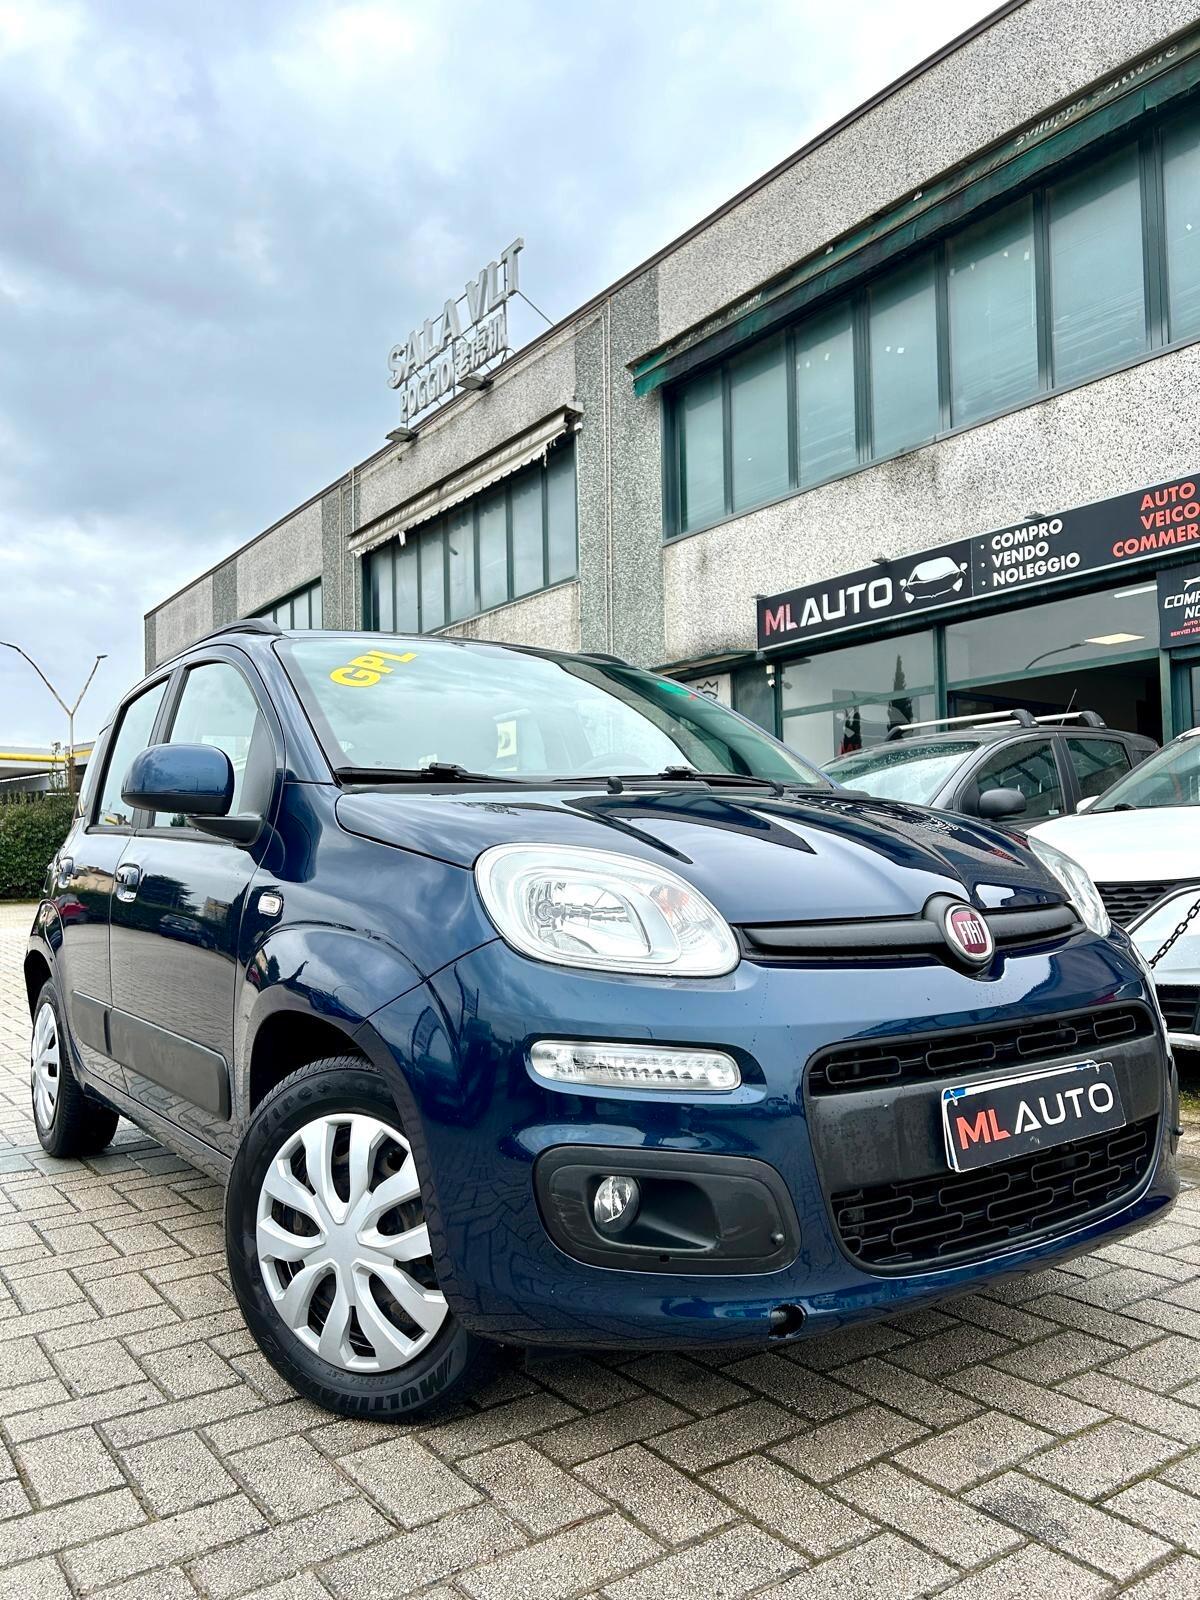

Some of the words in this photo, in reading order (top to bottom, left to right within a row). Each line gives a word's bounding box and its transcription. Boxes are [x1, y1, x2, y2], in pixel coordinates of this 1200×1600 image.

[387, 298, 461, 390] SALA
[465, 237, 524, 326] VLT
[1140, 482, 1196, 512] AUTO
[991, 518, 1063, 550] COMPRO
[1112, 523, 1200, 558] COMMER
[991, 541, 1049, 568] VENDO
[993, 552, 1081, 587] NOLEGGIO
[329, 650, 419, 688] GPL
[956, 920, 985, 945] FIAT
[956, 1108, 1011, 1150] ML
[1014, 1082, 1114, 1135] AUTO
